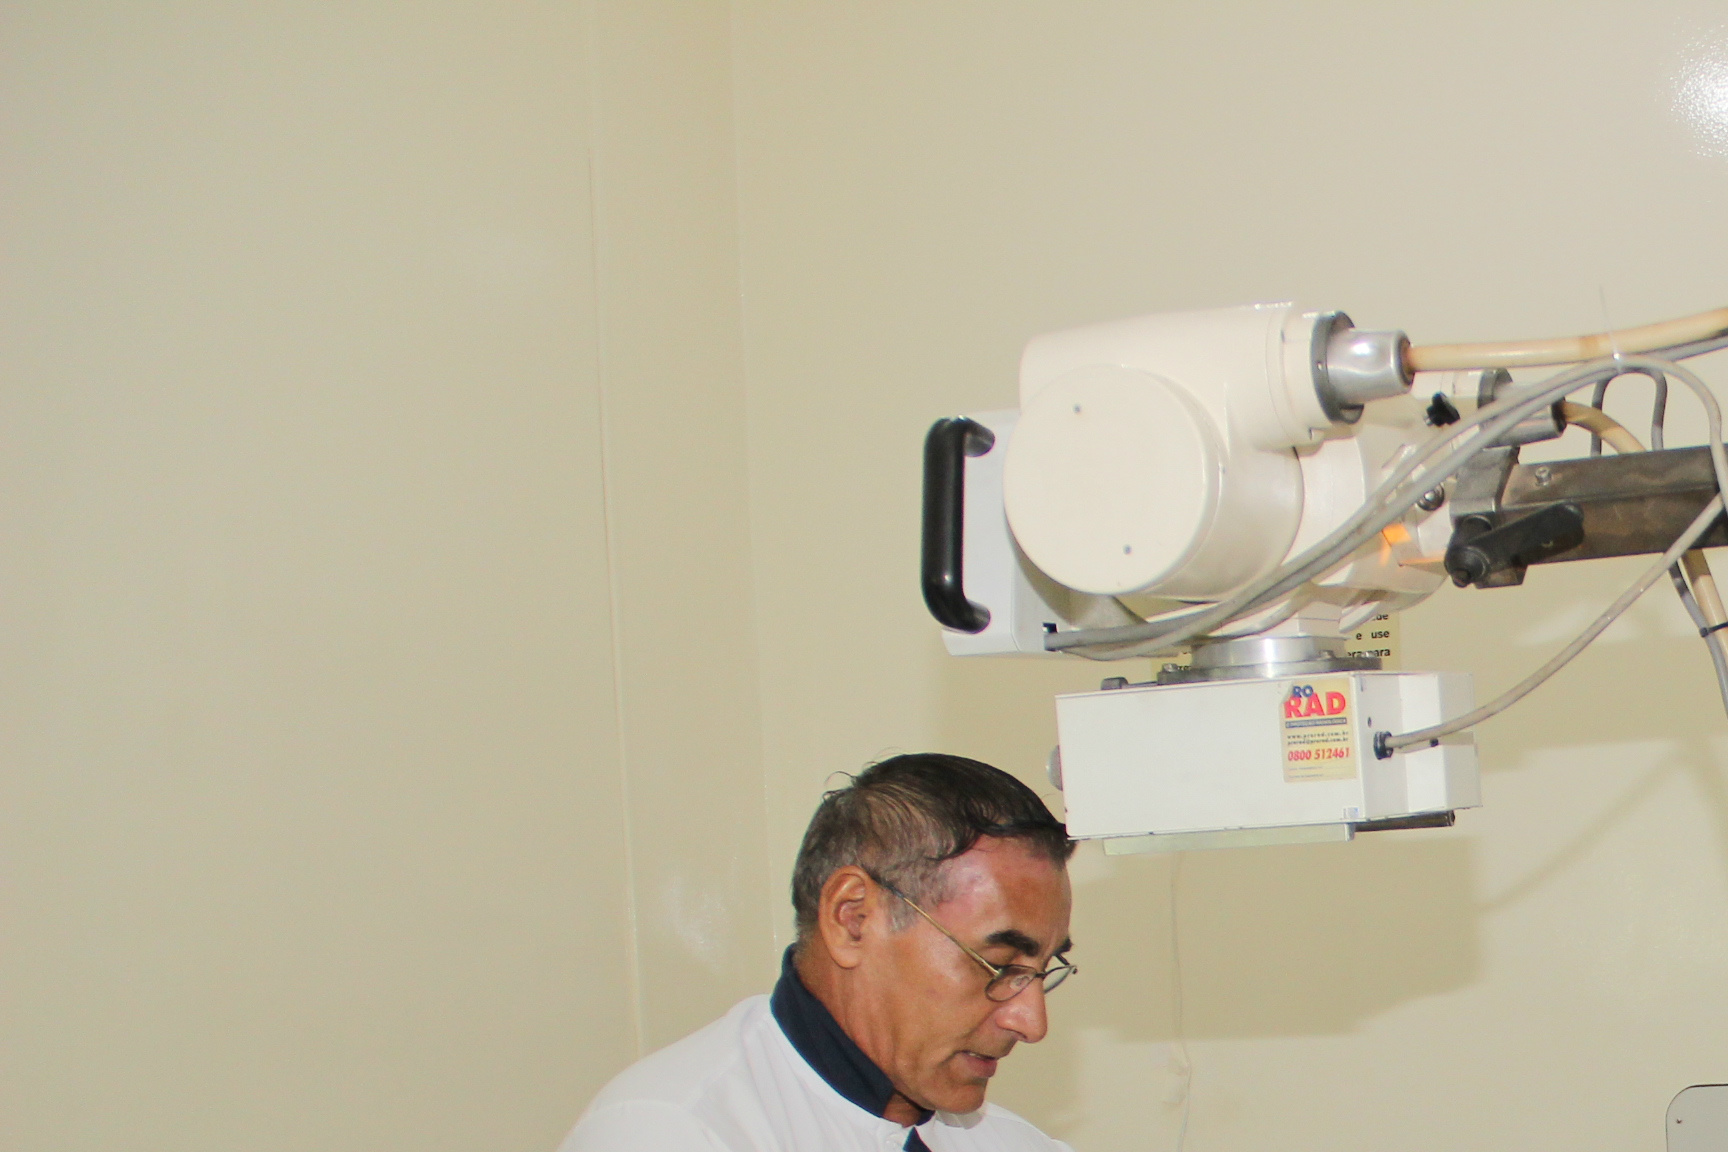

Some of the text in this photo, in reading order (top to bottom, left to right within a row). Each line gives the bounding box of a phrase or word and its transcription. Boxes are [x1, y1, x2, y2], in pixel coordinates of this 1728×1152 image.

[1370, 630, 1390, 639] use
[1283, 691, 1346, 718] RAD
[1287, 747, 1351, 762] 0800 512461
